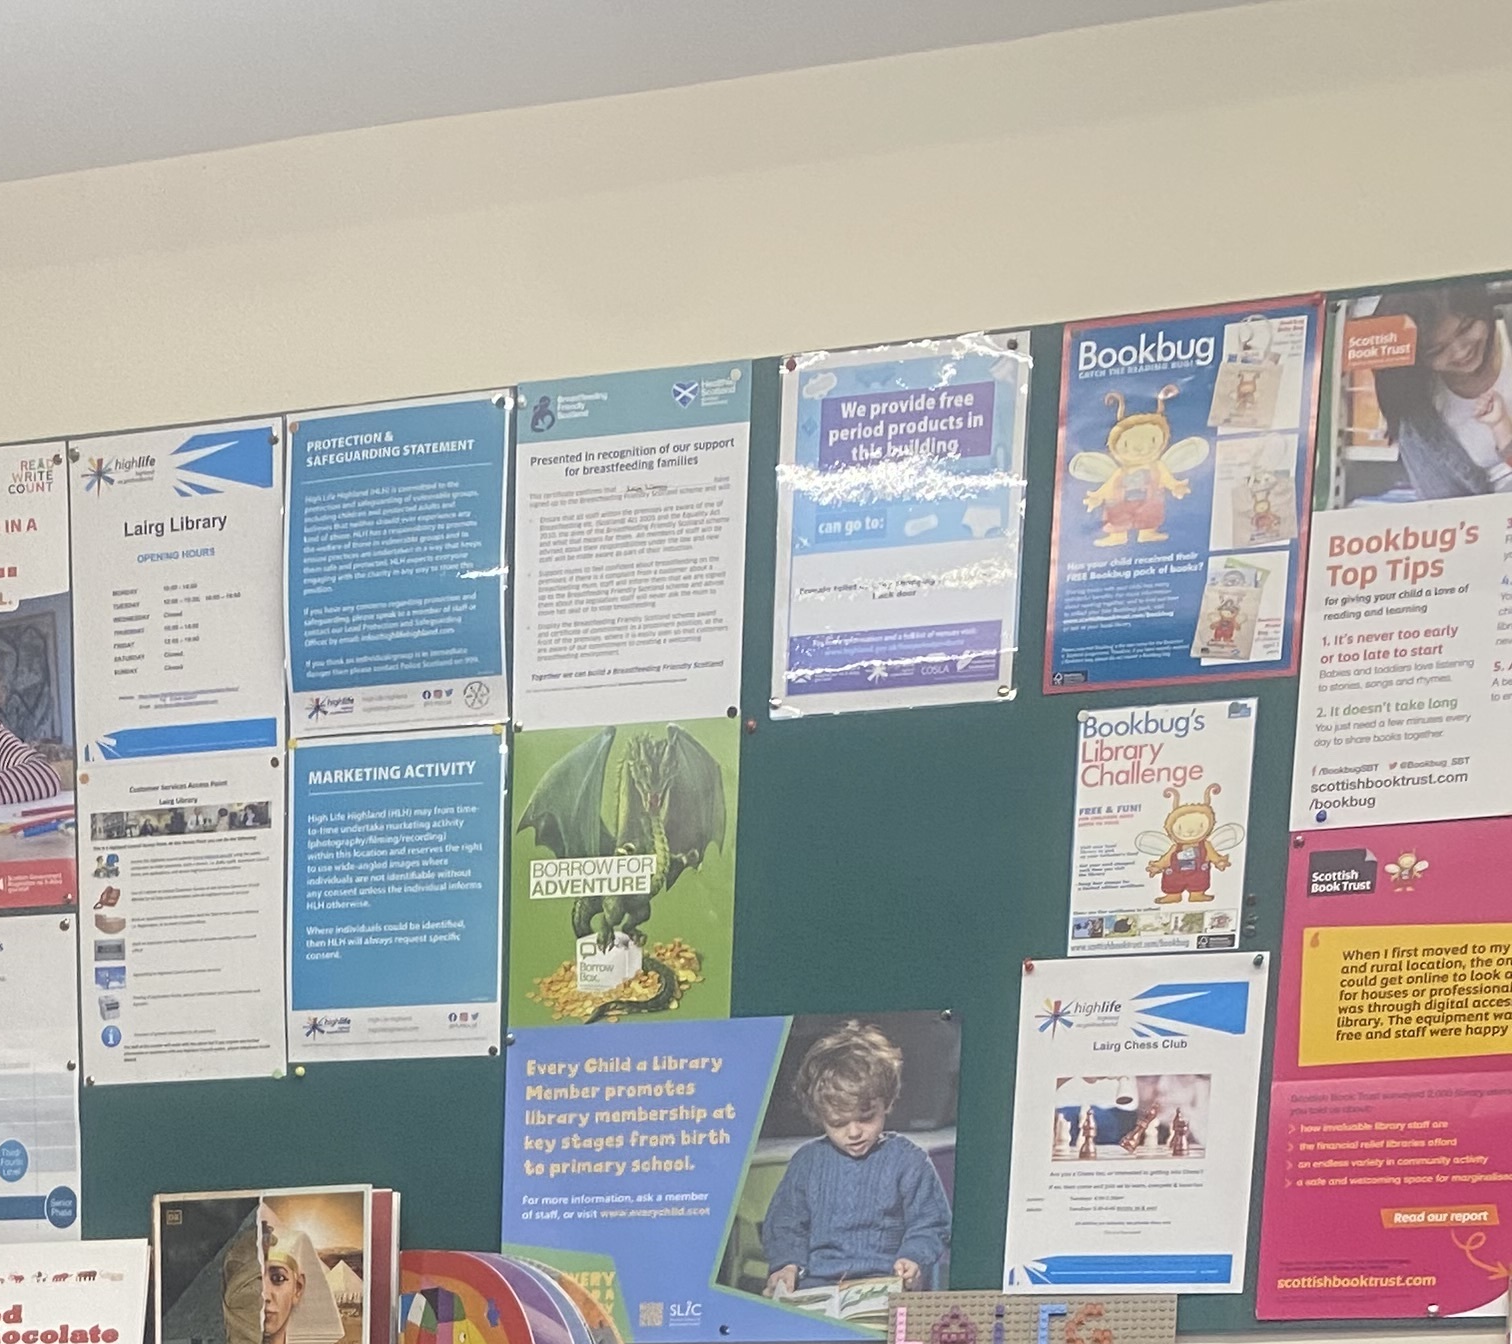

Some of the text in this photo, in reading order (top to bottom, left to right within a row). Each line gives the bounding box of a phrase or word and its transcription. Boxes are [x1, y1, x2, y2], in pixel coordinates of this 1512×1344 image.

[1078, 334, 1215, 373] Bookbug
[841, 392, 974, 418] We provide free
[828, 412, 984, 445] period products in
[307, 431, 393, 453] PROTECTION &
[307, 439, 474, 468] SAFEGUARDING STATEMENT
[5, 519, 20, 533] IN
[25, 518, 37, 532] A
[124, 514, 227, 538] Lairg Library
[1328, 522, 1479, 559] Bookbug's
[1326, 555, 1444, 591] Top Tips
[1082, 710, 1205, 739] Bookbug's
[1082, 740, 1163, 765] Library
[309, 761, 475, 784] MARKETING ACTIVITY
[1081, 761, 1203, 788] Challenge
[1311, 772, 1468, 793] scottishbooktrust.com
[1309, 795, 1375, 811] /bookbug
[532, 858, 653, 878] BORROW FOR
[1312, 869, 1358, 882] Scottish
[532, 877, 647, 896] ADVENTURE
[1311, 879, 1370, 894] Book Trust
[1343, 944, 1510, 960] When I first moved to my
[1336, 1025, 1508, 1040] free and staff were happy
[1093, 1038, 1187, 1052] Lairg Chess Club
[526, 1056, 722, 1078] Every Child a Library
[526, 1081, 694, 1101] Member promotes
[525, 1106, 735, 1126] library membership at
[524, 1130, 730, 1152] key stages from birth
[524, 1157, 694, 1178] to primary school.
[1394, 1210, 1488, 1224] Read our report
[1277, 1272, 1436, 1288] scottishbooktrust.com
